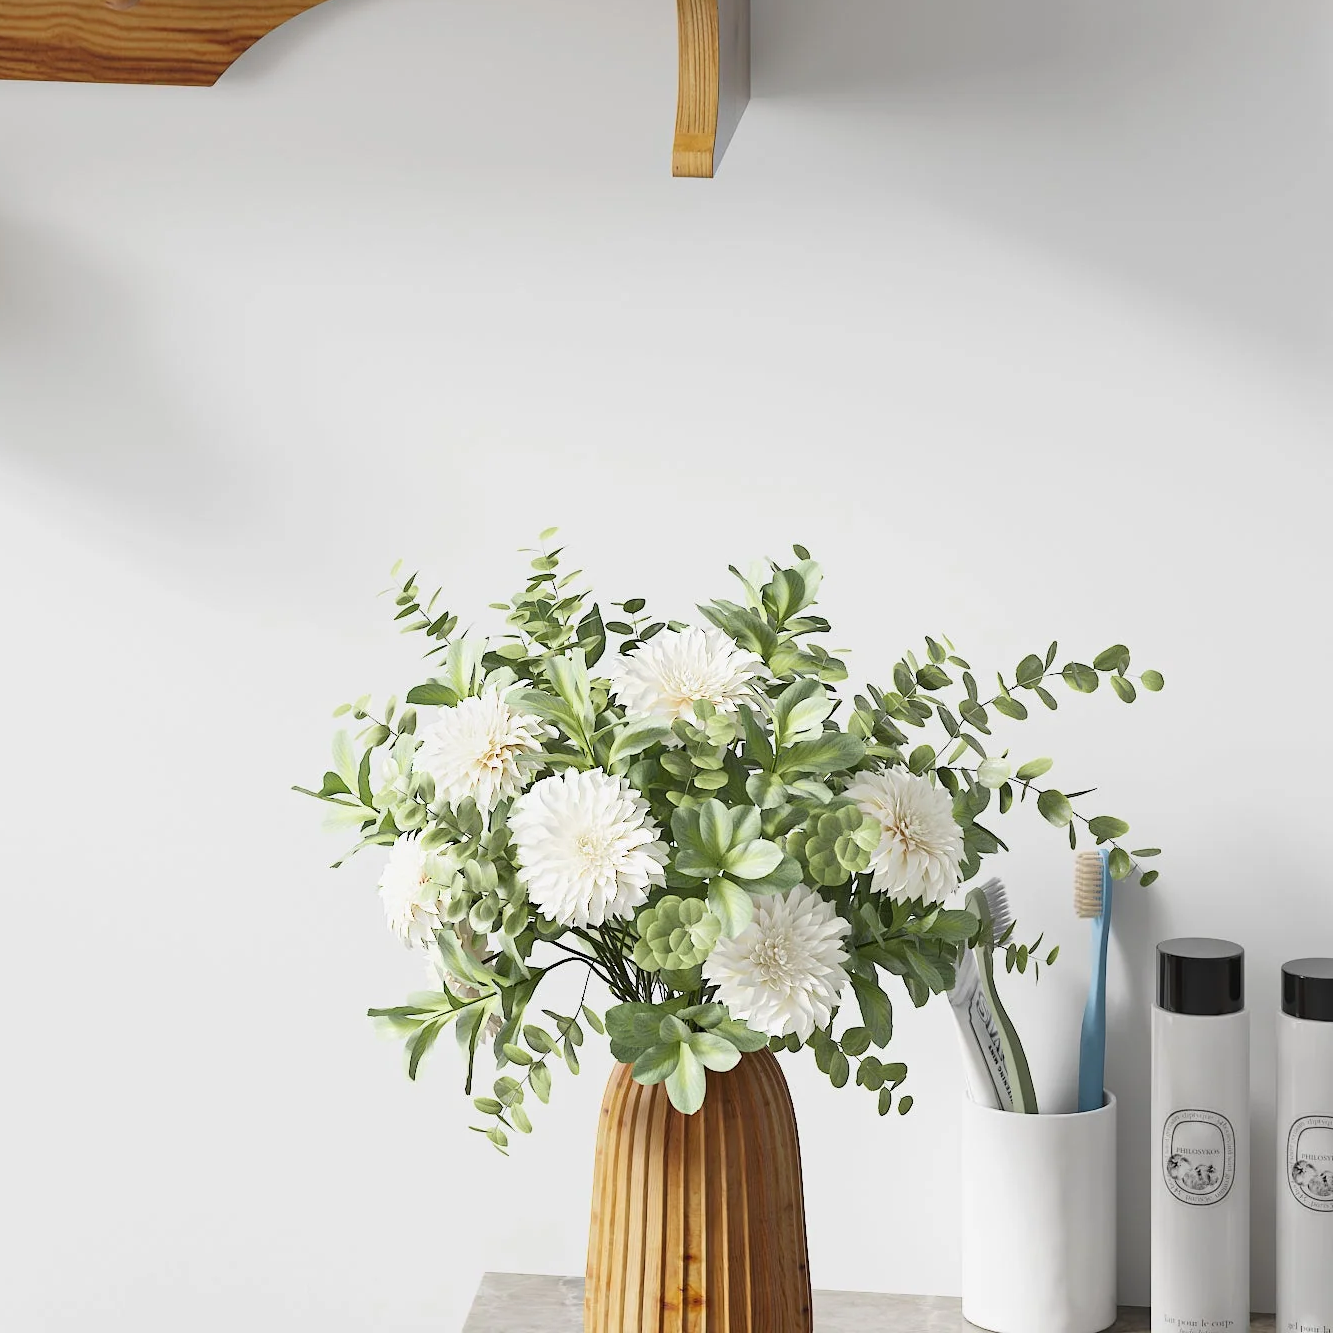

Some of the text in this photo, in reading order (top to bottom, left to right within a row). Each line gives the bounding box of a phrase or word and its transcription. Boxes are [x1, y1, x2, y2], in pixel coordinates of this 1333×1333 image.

[1176, 1147, 1220, 1156] PHILOSYKOS
[1178, 1318, 1198, 1327] pour
[1201, 1318, 1209, 1327] le
